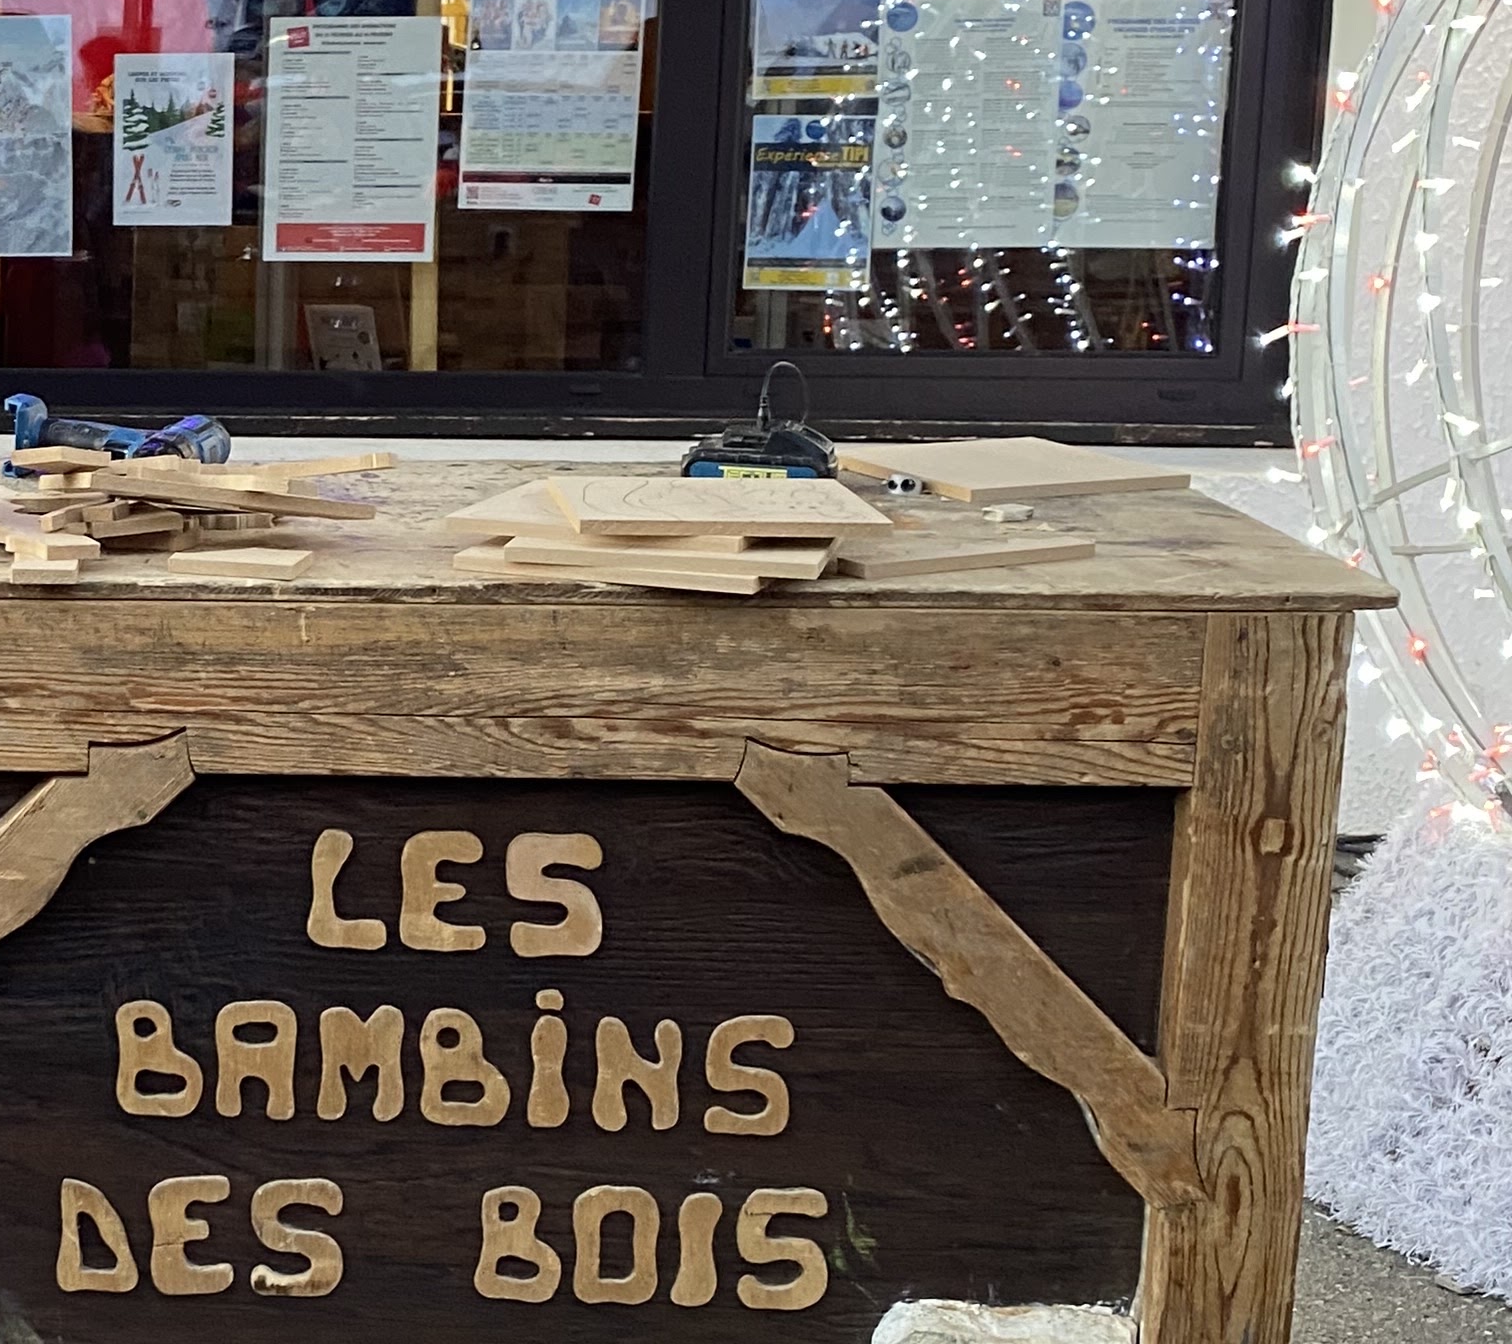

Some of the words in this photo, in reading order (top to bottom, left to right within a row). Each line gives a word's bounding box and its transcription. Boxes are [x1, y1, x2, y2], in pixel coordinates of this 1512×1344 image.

[306, 828, 604, 957] LES
[55, 1174, 345, 1297] DES
[473, 1184, 829, 1312] BOIS
